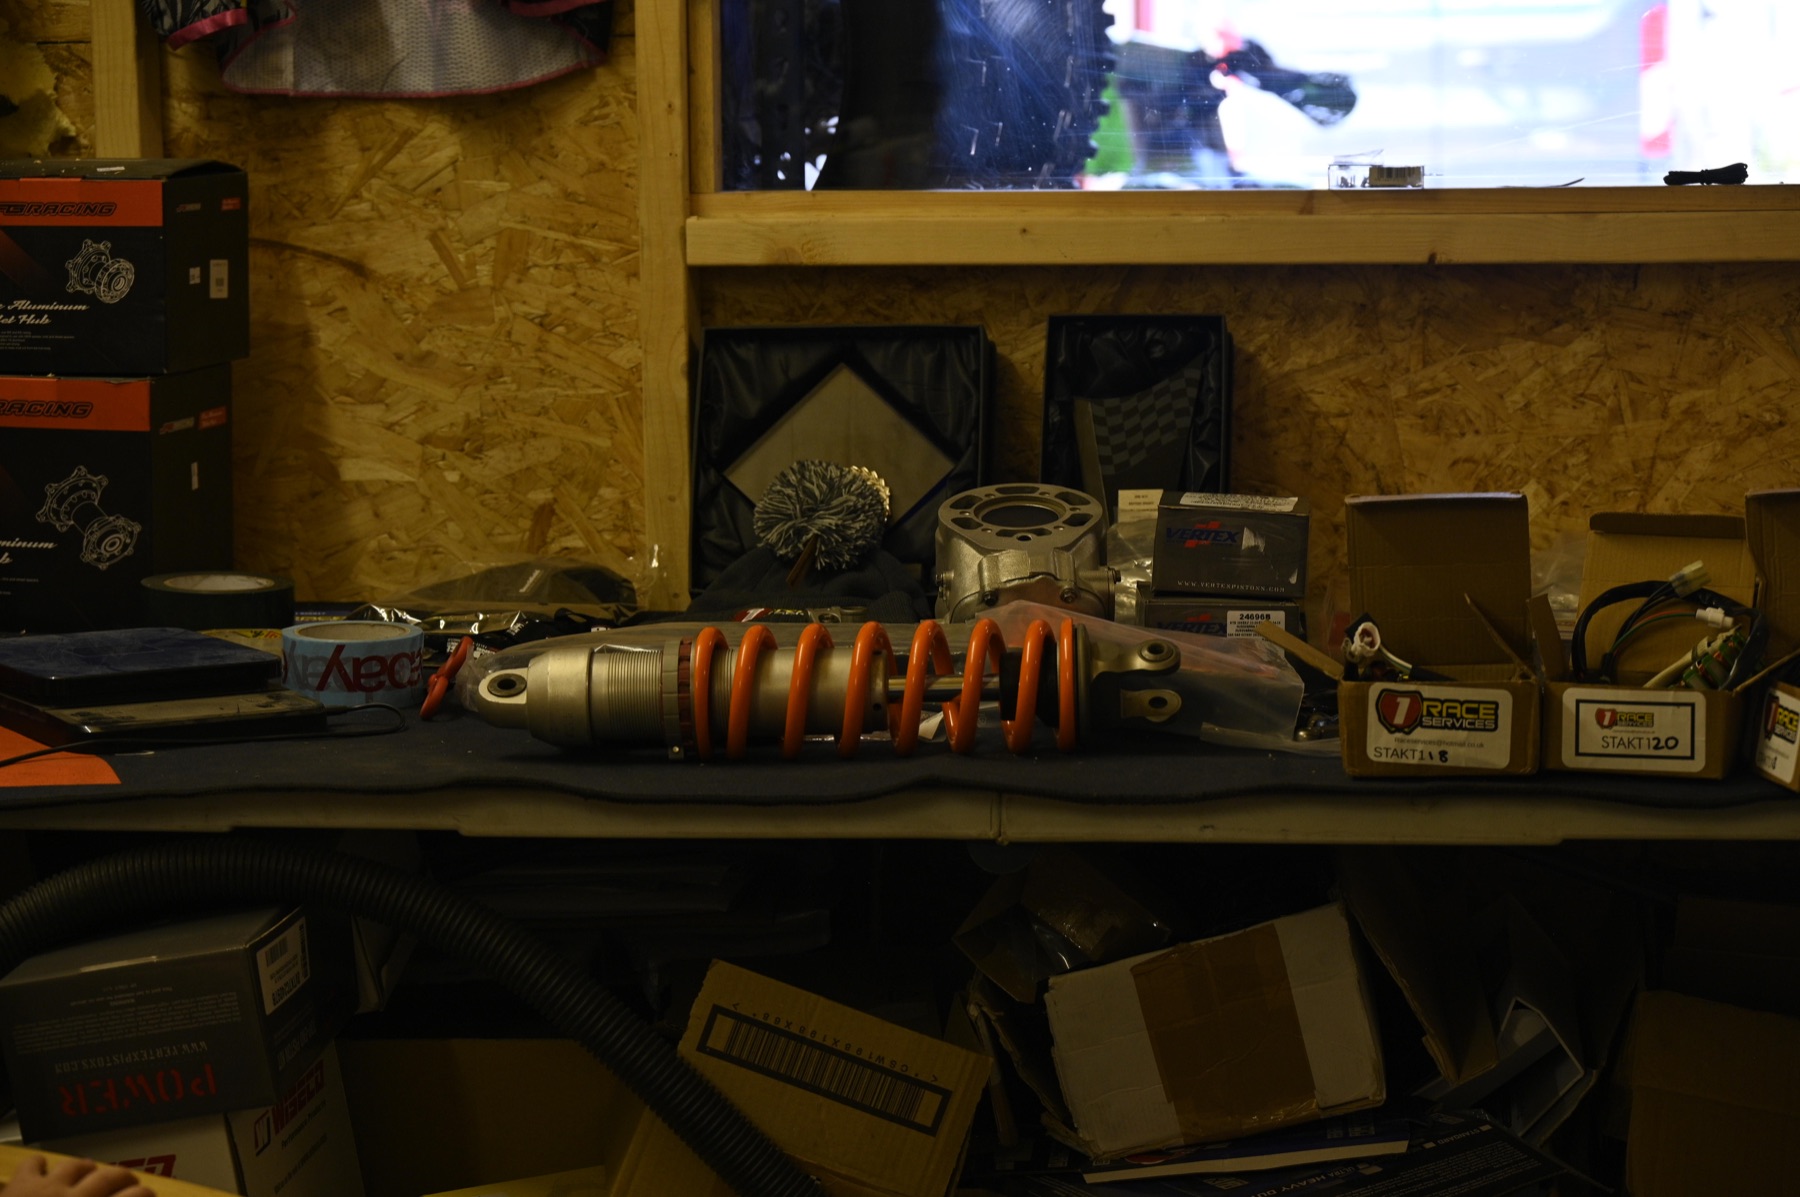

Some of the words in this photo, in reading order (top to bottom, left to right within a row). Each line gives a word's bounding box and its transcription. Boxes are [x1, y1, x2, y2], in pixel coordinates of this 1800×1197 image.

[8, 300, 90, 311] Aluminum
[18, 313, 52, 325] Hub
[1166, 527, 1240, 543] VERTEX
[1177, 580, 1285, 593] WWW.VERTEXPISTONS.COM
[1422, 700, 1497, 720] RACE
[1617, 712, 1653, 722] RACE
[1421, 716, 1496, 730] SERVICES
[57, 1062, 218, 1118] POWER
[1436, 1127, 1481, 1145] STANDARD
[1332, 1166, 1358, 1179] ULTRA
[1280, 1171, 1332, 1192] HEAVY
